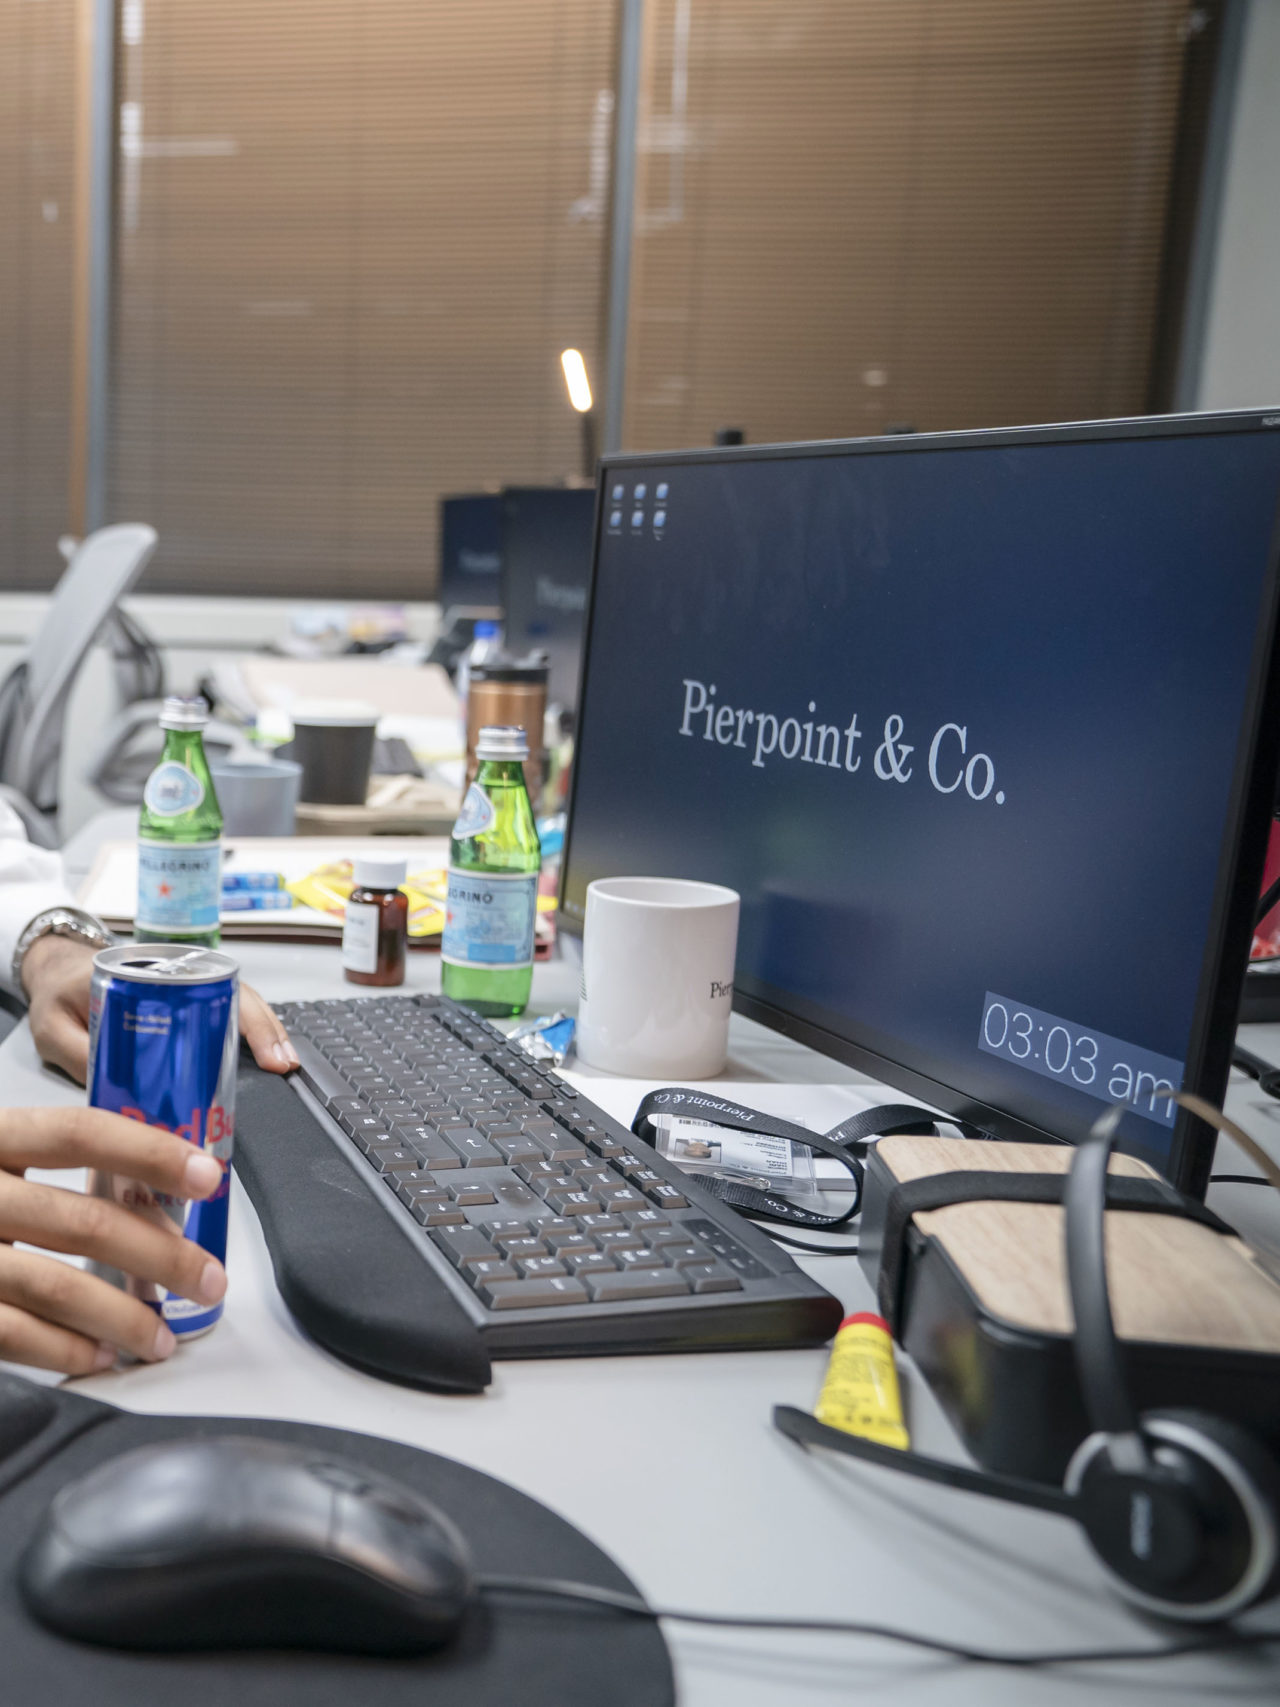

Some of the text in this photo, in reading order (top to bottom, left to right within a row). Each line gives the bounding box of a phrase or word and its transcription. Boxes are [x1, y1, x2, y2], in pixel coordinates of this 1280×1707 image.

[679, 679, 1006, 805] Pierpoint & Co.
[984, 1003, 1174, 1119] 03:03 am
[687, 1095, 755, 1121] Pierpoint
[764, 1198, 789, 1212] Co.
